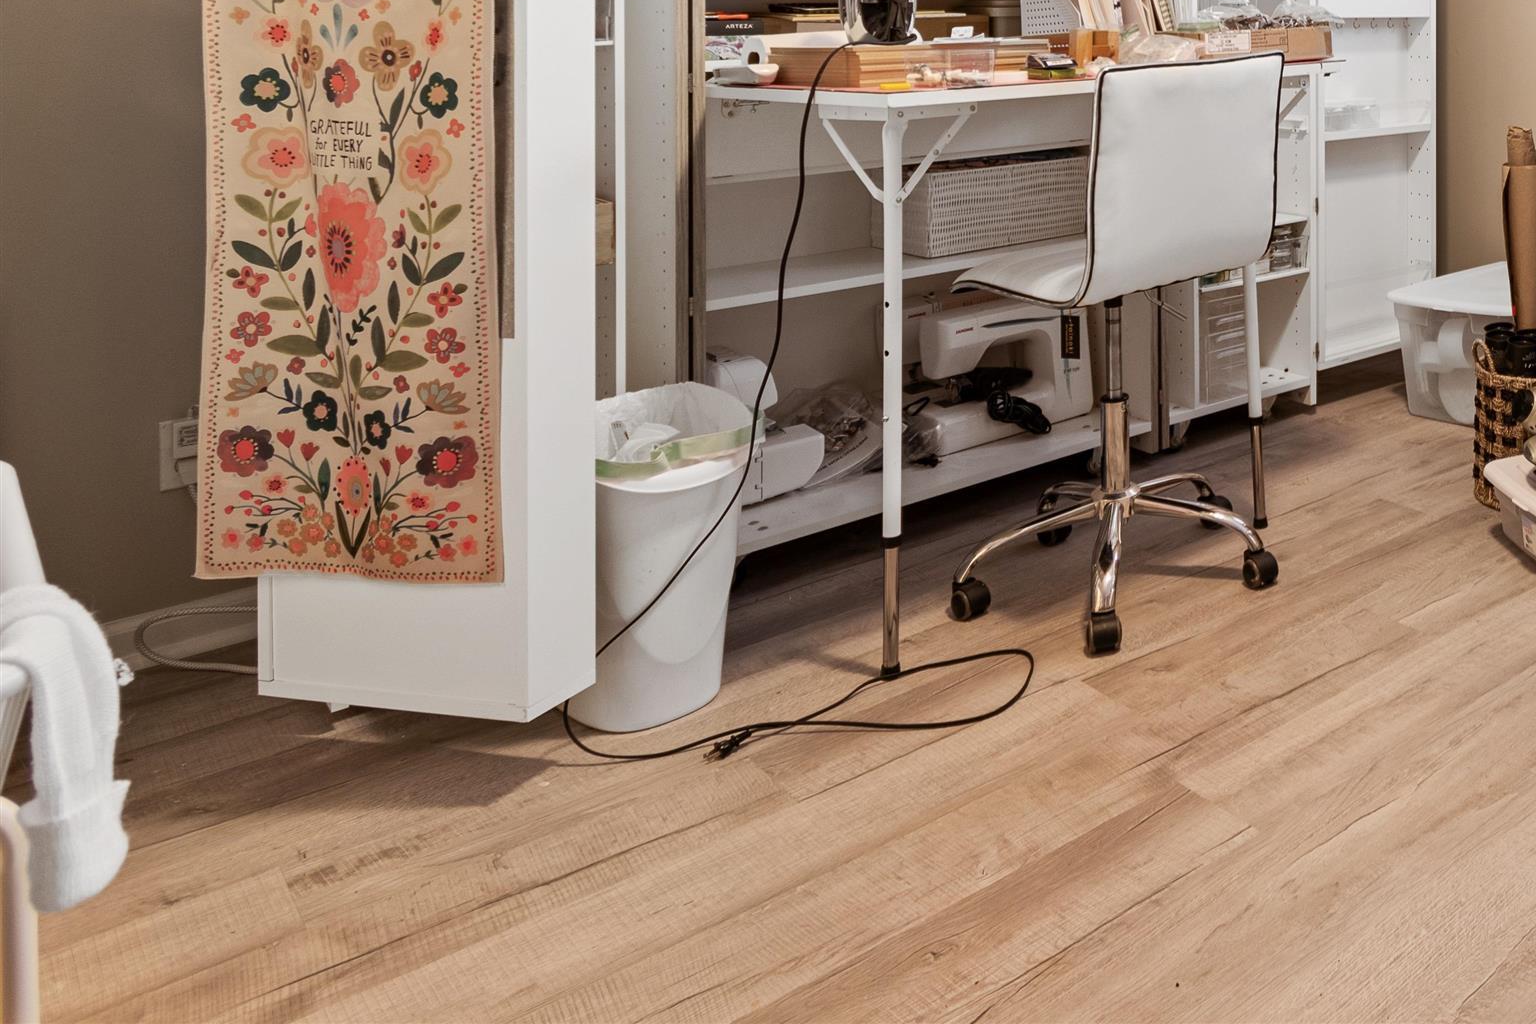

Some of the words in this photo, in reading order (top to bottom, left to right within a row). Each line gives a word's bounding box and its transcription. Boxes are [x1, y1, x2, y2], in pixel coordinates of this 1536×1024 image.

[310, 118, 372, 137] GRATEFUL
[315, 138, 327, 151] for
[333, 139, 364, 153] EVERY
